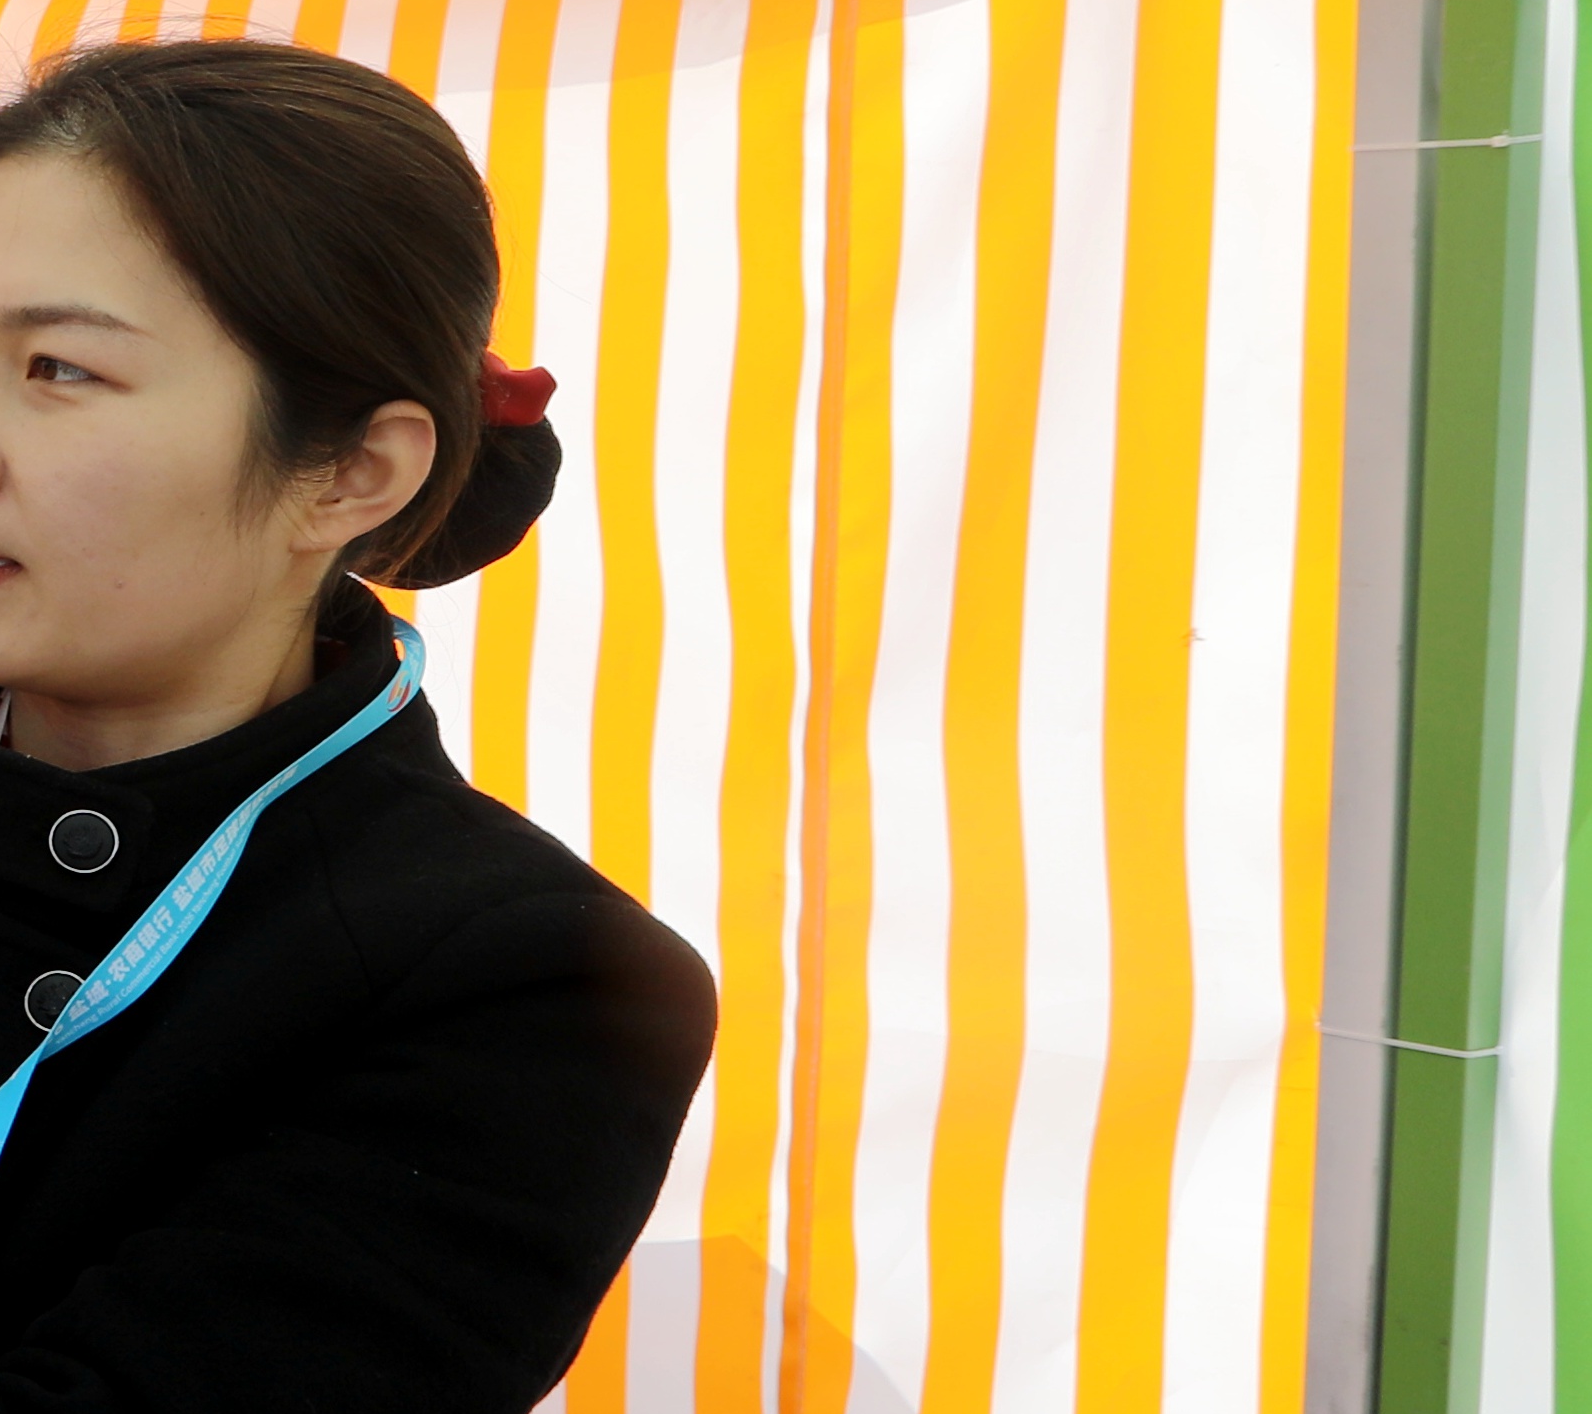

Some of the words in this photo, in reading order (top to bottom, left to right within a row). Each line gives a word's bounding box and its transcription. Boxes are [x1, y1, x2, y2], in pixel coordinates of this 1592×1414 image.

[68, 905, 175, 1023] 盐城·农商银行
